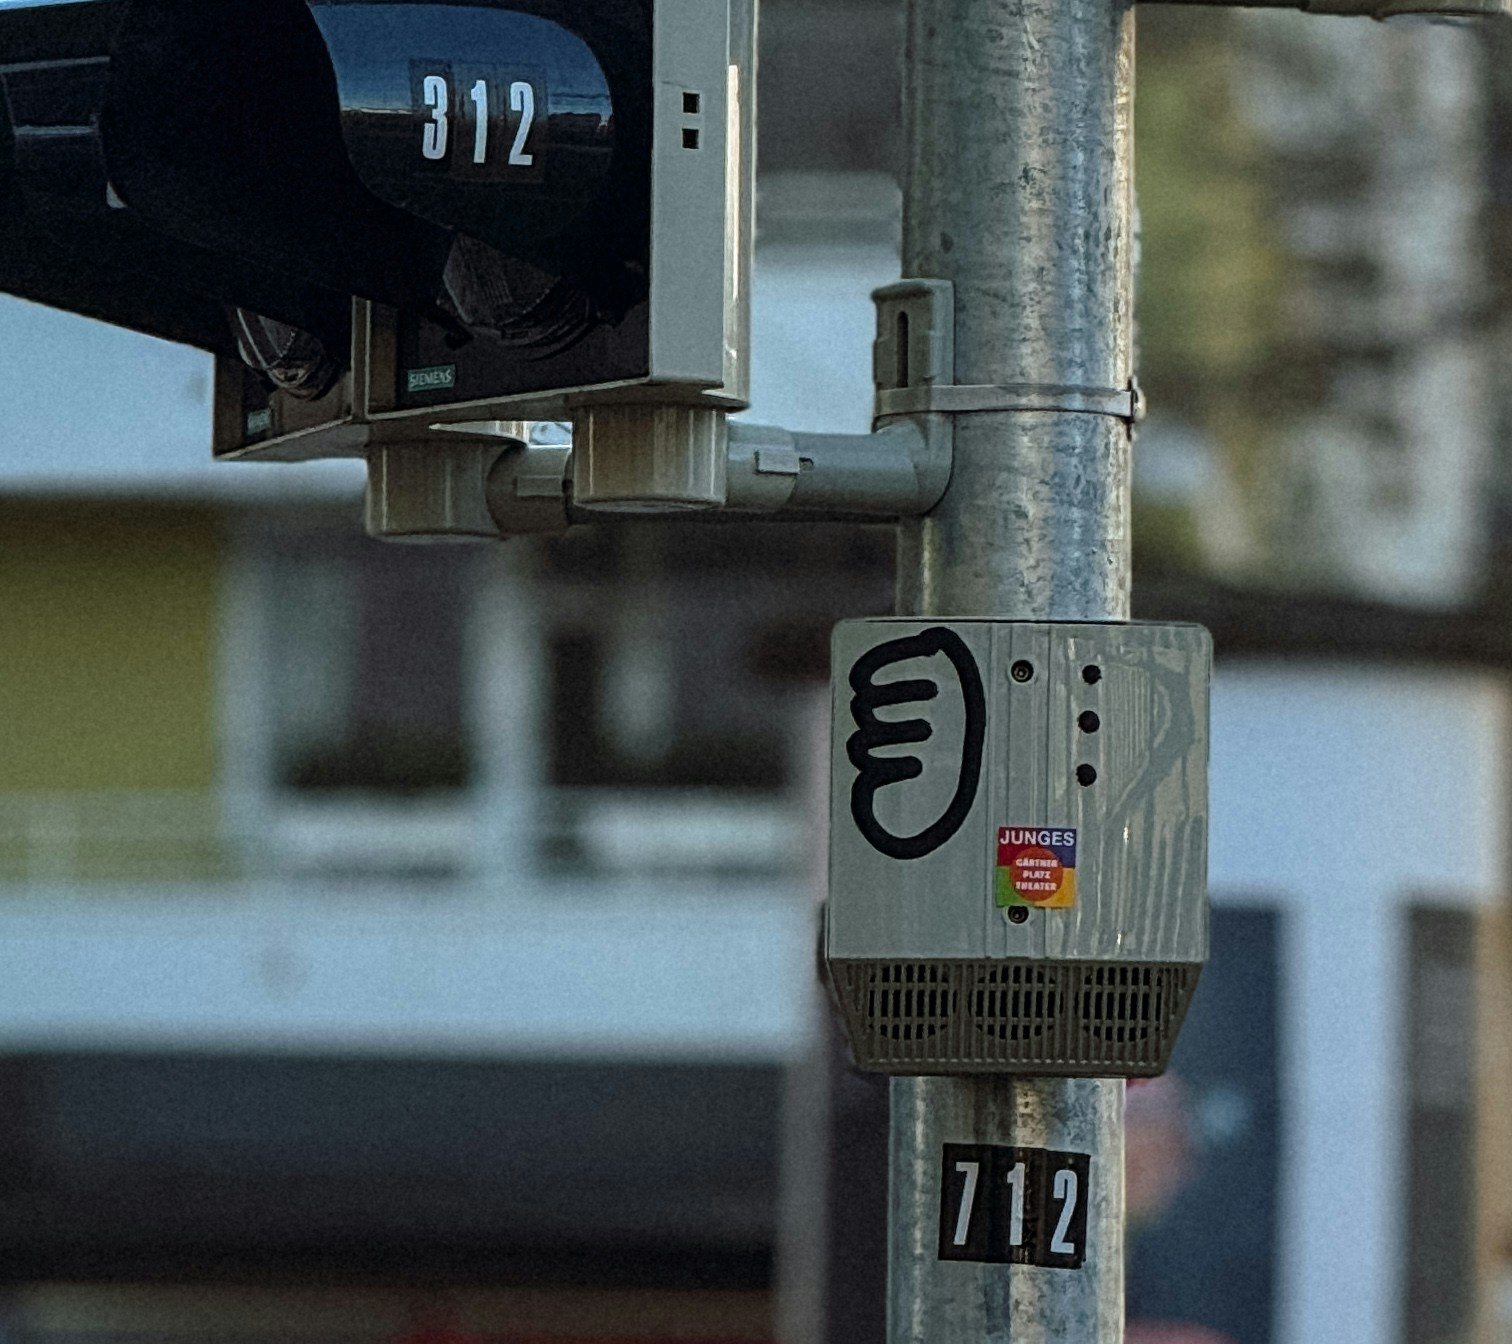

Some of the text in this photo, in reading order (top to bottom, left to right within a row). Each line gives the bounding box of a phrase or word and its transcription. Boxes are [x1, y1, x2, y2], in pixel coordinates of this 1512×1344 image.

[422, 75, 534, 165] 312
[1000, 829, 1075, 847] JUNGES
[953, 1162, 1078, 1254] 712
